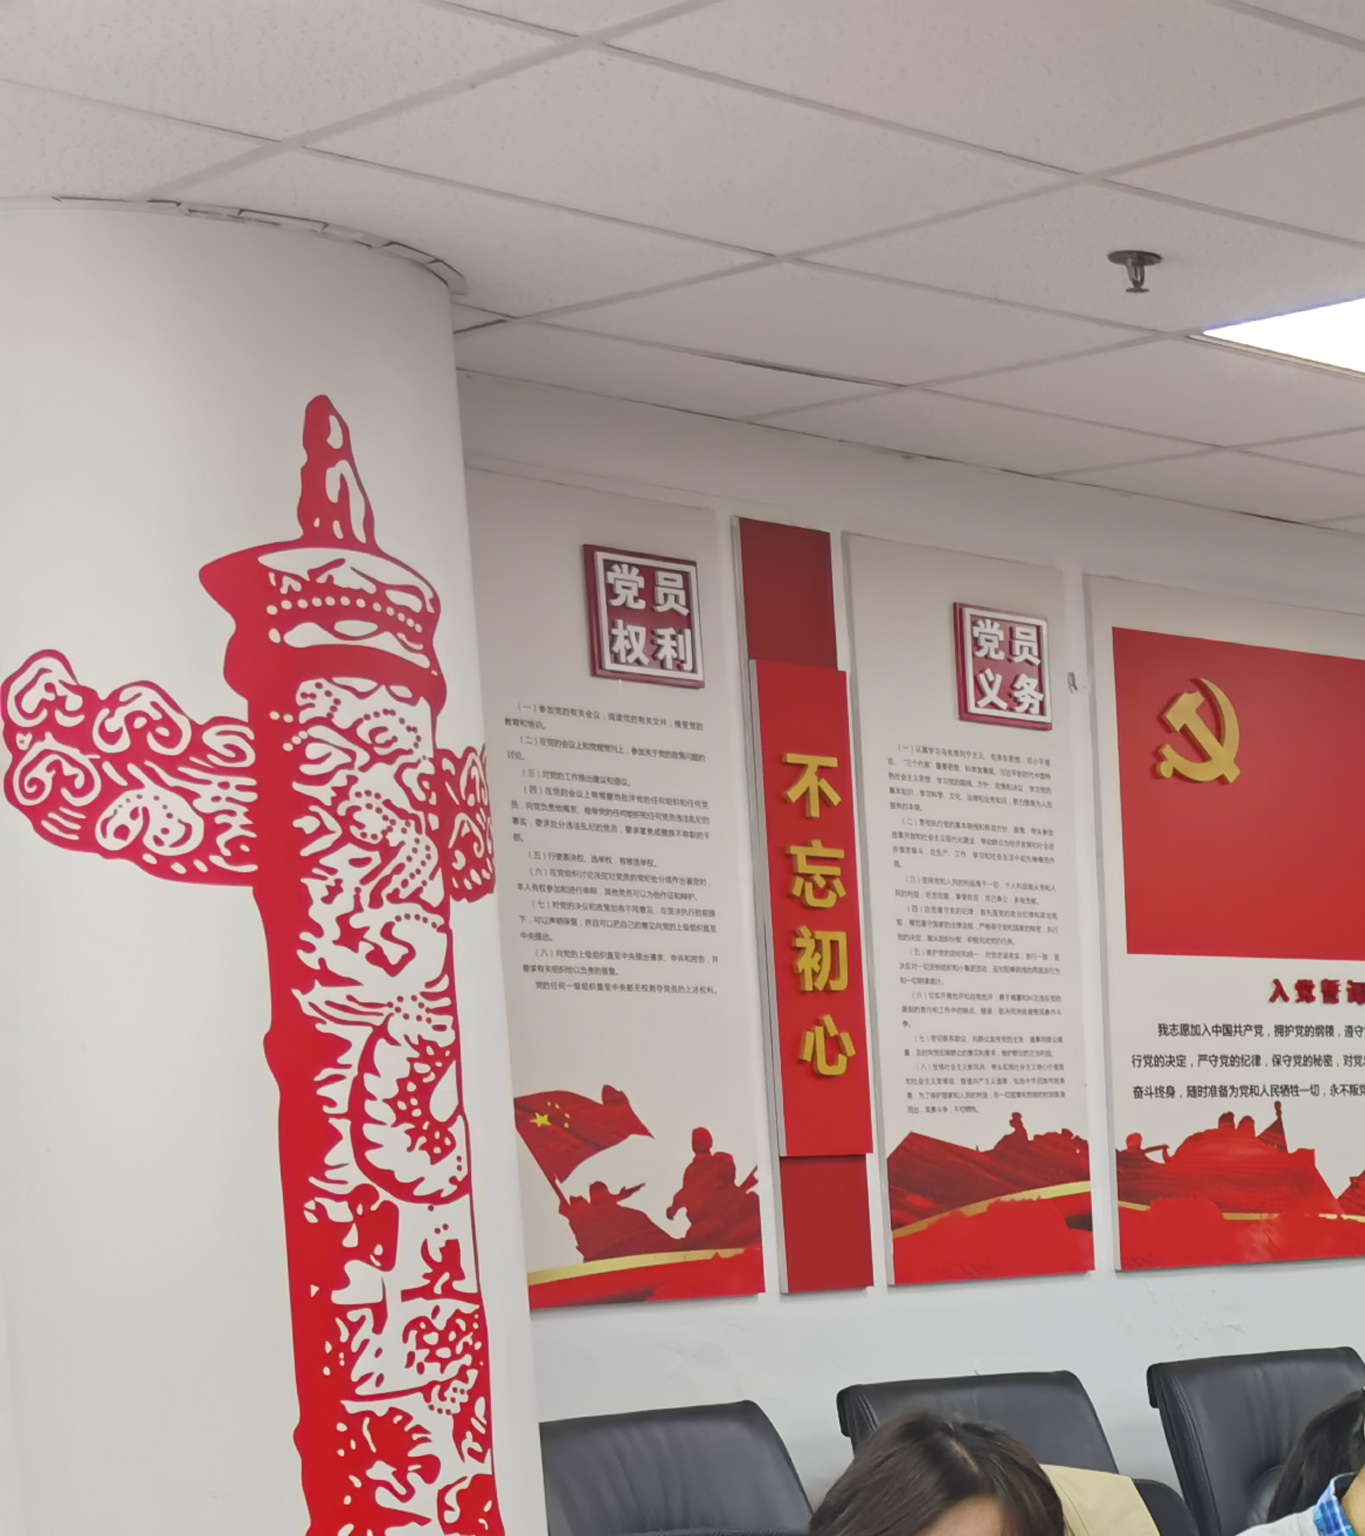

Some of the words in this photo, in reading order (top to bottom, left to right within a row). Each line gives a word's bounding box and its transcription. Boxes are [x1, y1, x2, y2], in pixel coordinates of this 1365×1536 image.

[606, 564, 690, 617] 党员
[611, 619, 693, 671] 权利
[973, 619, 1041, 665] 党员
[977, 669, 1044, 715] 义务
[782, 753, 856, 1078] 不忘初心
